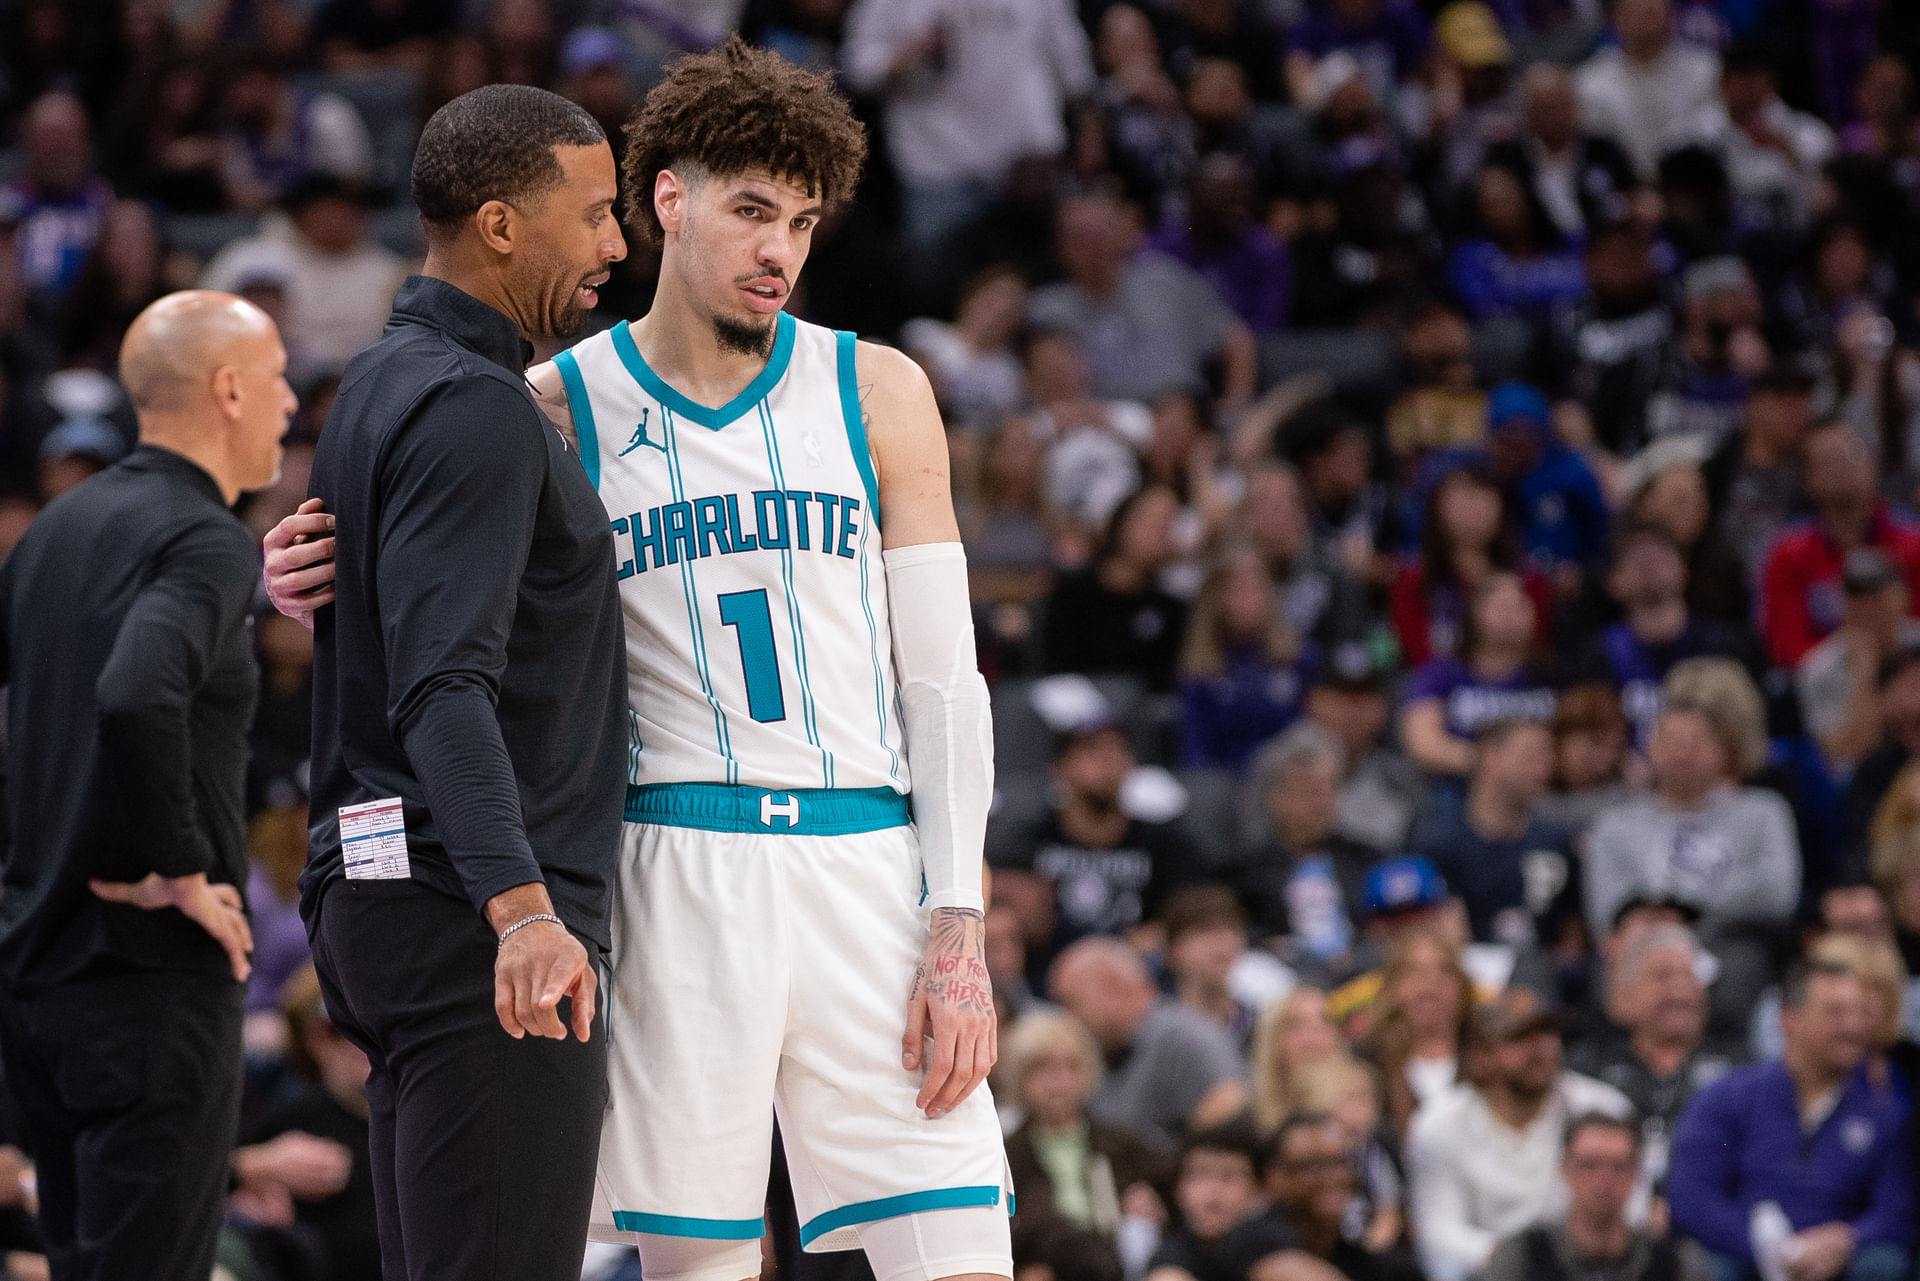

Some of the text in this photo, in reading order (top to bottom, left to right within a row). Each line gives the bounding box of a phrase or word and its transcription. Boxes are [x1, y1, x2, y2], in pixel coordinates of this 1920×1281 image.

[611, 489, 860, 581] CHARLOTTE
[717, 588, 786, 723] 1
[934, 955, 962, 976] NOT
[945, 980, 989, 1008] HERE
